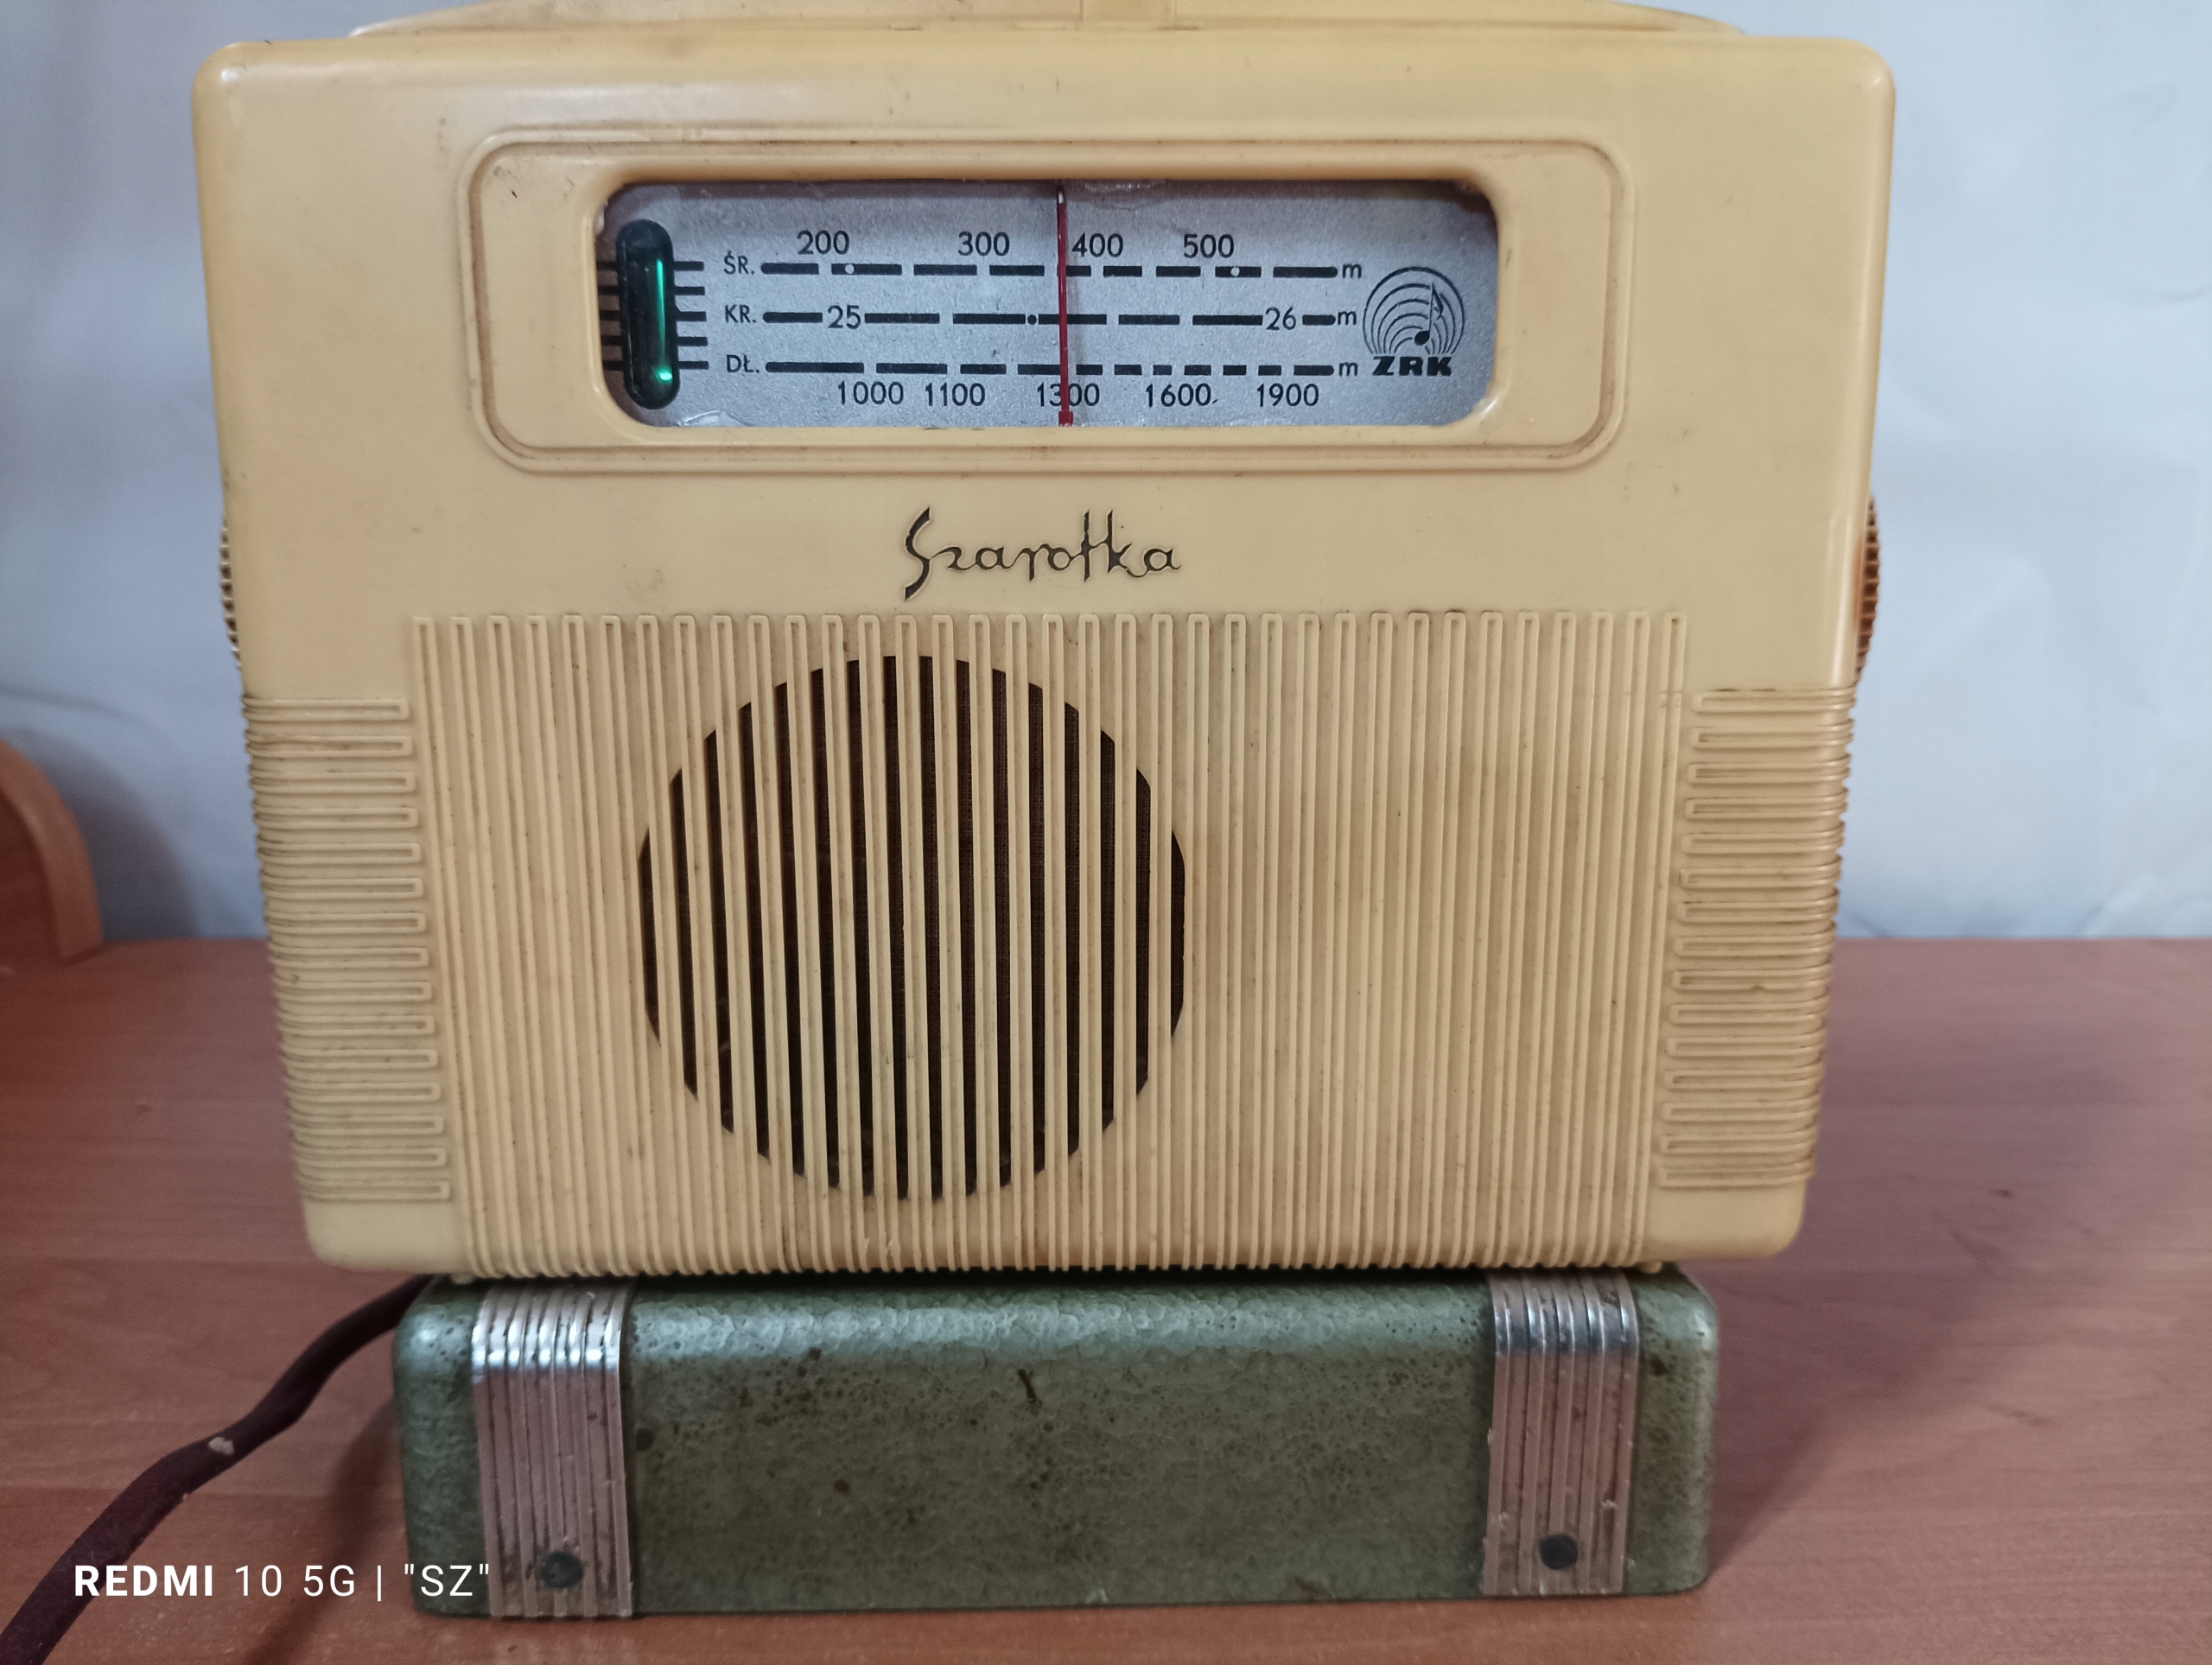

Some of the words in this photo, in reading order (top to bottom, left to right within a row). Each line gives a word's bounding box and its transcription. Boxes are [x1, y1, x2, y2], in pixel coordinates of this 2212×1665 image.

[797, 230, 850, 255] 200
[957, 232, 1010, 257] 300
[1071, 233, 1123, 258] 400
[1183, 234, 1235, 258] 500
[723, 251, 755, 276] ŚR.
[1341, 264, 1362, 278] m
[724, 305, 757, 324] KR.
[827, 306, 861, 329] 25
[1265, 308, 1297, 331] 26
[1337, 312, 1357, 326] m
[726, 354, 760, 373] DŁ.
[1338, 363, 1358, 377] m
[1371, 356, 1452, 377] ZRK
[837, 381, 904, 405] 1000
[925, 383, 986, 406] 1100
[1037, 384, 1100, 407] 1300
[1146, 384, 1210, 407] 1600
[1256, 384, 1319, 407] 1900
[904, 505, 1181, 601] Szarotka
